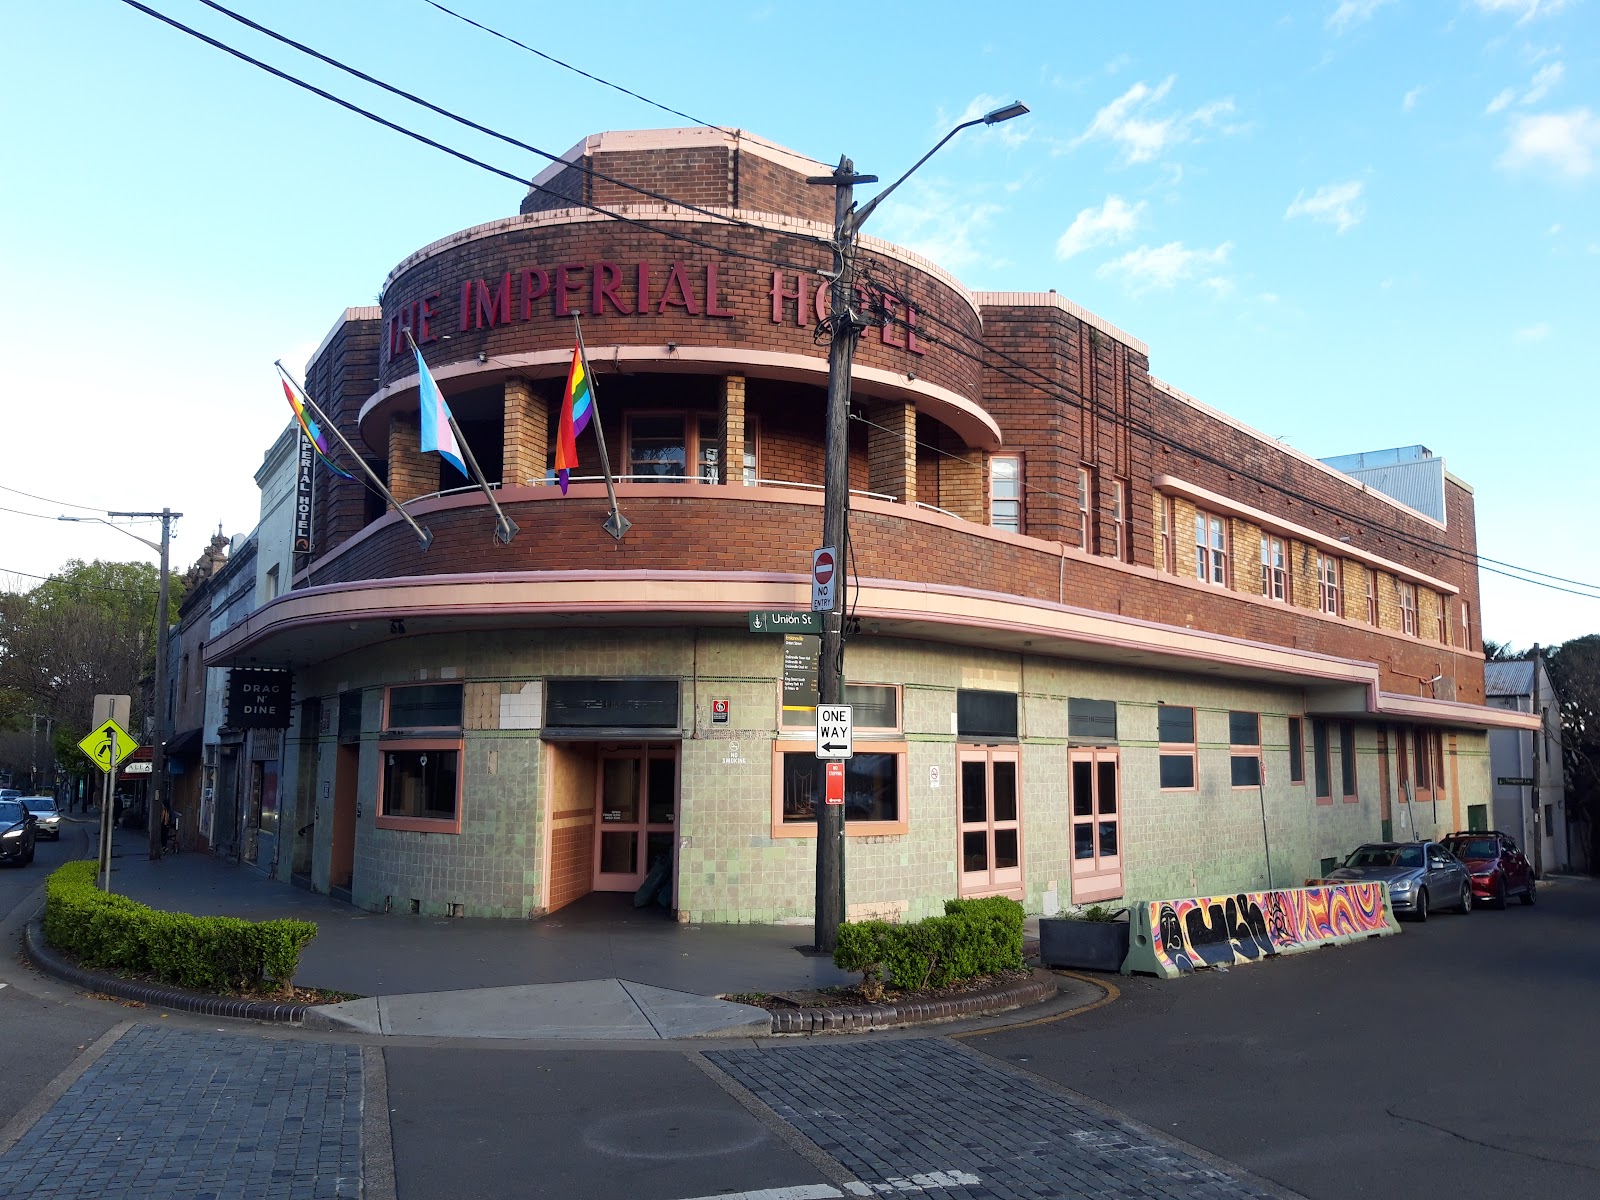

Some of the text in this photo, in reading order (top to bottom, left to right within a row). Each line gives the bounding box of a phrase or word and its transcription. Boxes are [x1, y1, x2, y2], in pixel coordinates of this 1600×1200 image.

[388, 291, 440, 363] THE
[459, 261, 735, 332] IMPERIAL
[298, 433, 312, 537] MPERIAL HOTEL
[817, 586, 829, 597] NO
[814, 598, 832, 608] ENTRY
[802, 613, 813, 625] St
[243, 684, 280, 693] DRAG
[243, 705, 276, 715] DINE
[822, 710, 847, 722] ONE
[820, 726, 848, 738] WAY
